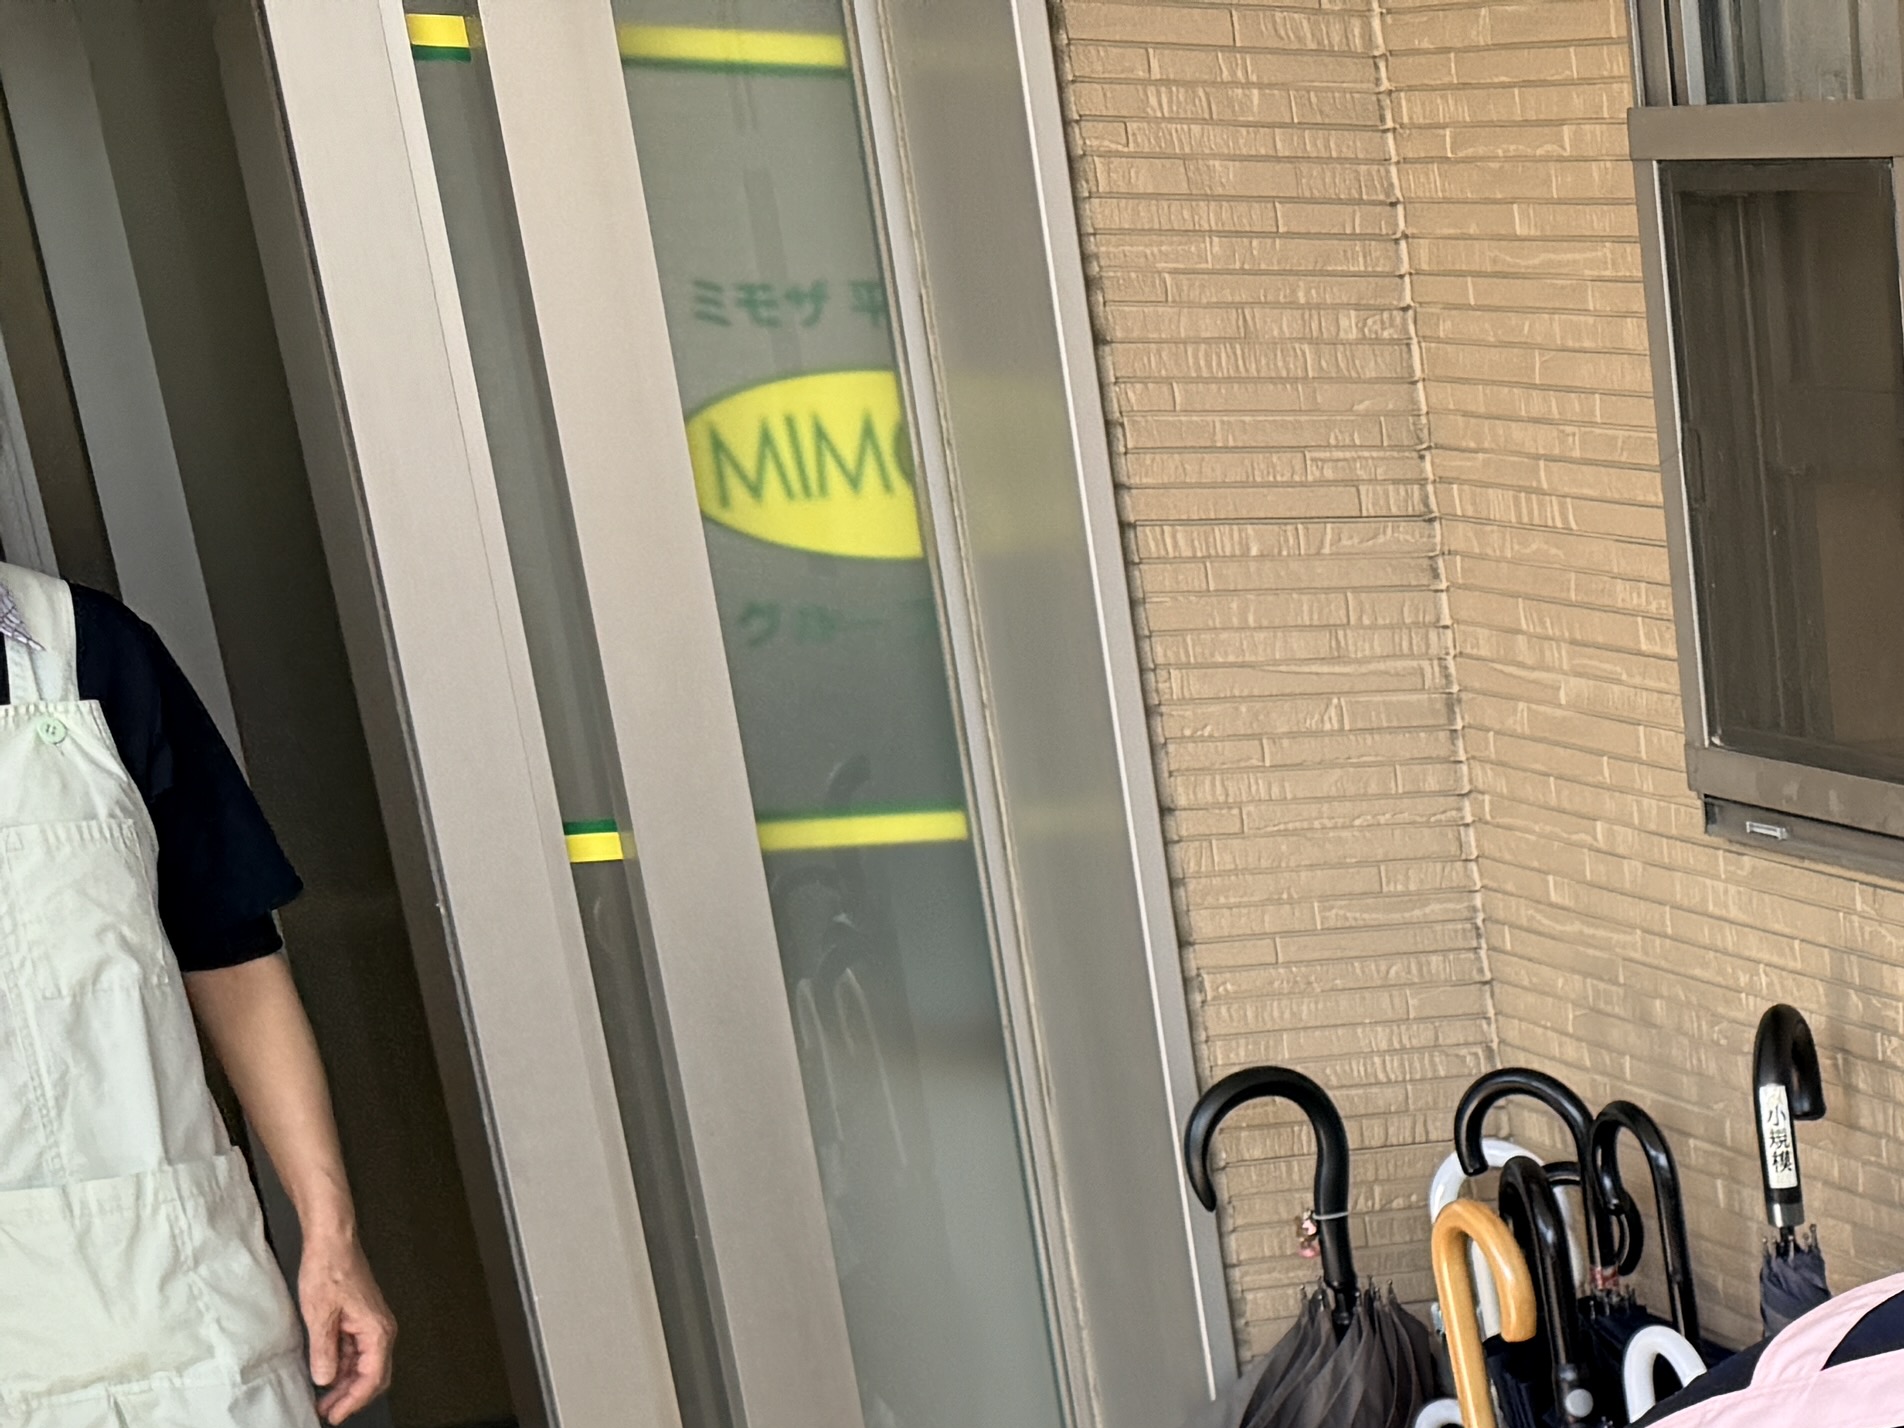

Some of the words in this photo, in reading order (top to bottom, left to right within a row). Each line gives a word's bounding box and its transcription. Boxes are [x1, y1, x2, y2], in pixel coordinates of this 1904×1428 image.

[707, 408, 916, 509] MIM
[1767, 1103, 1793, 1174] 小規模
